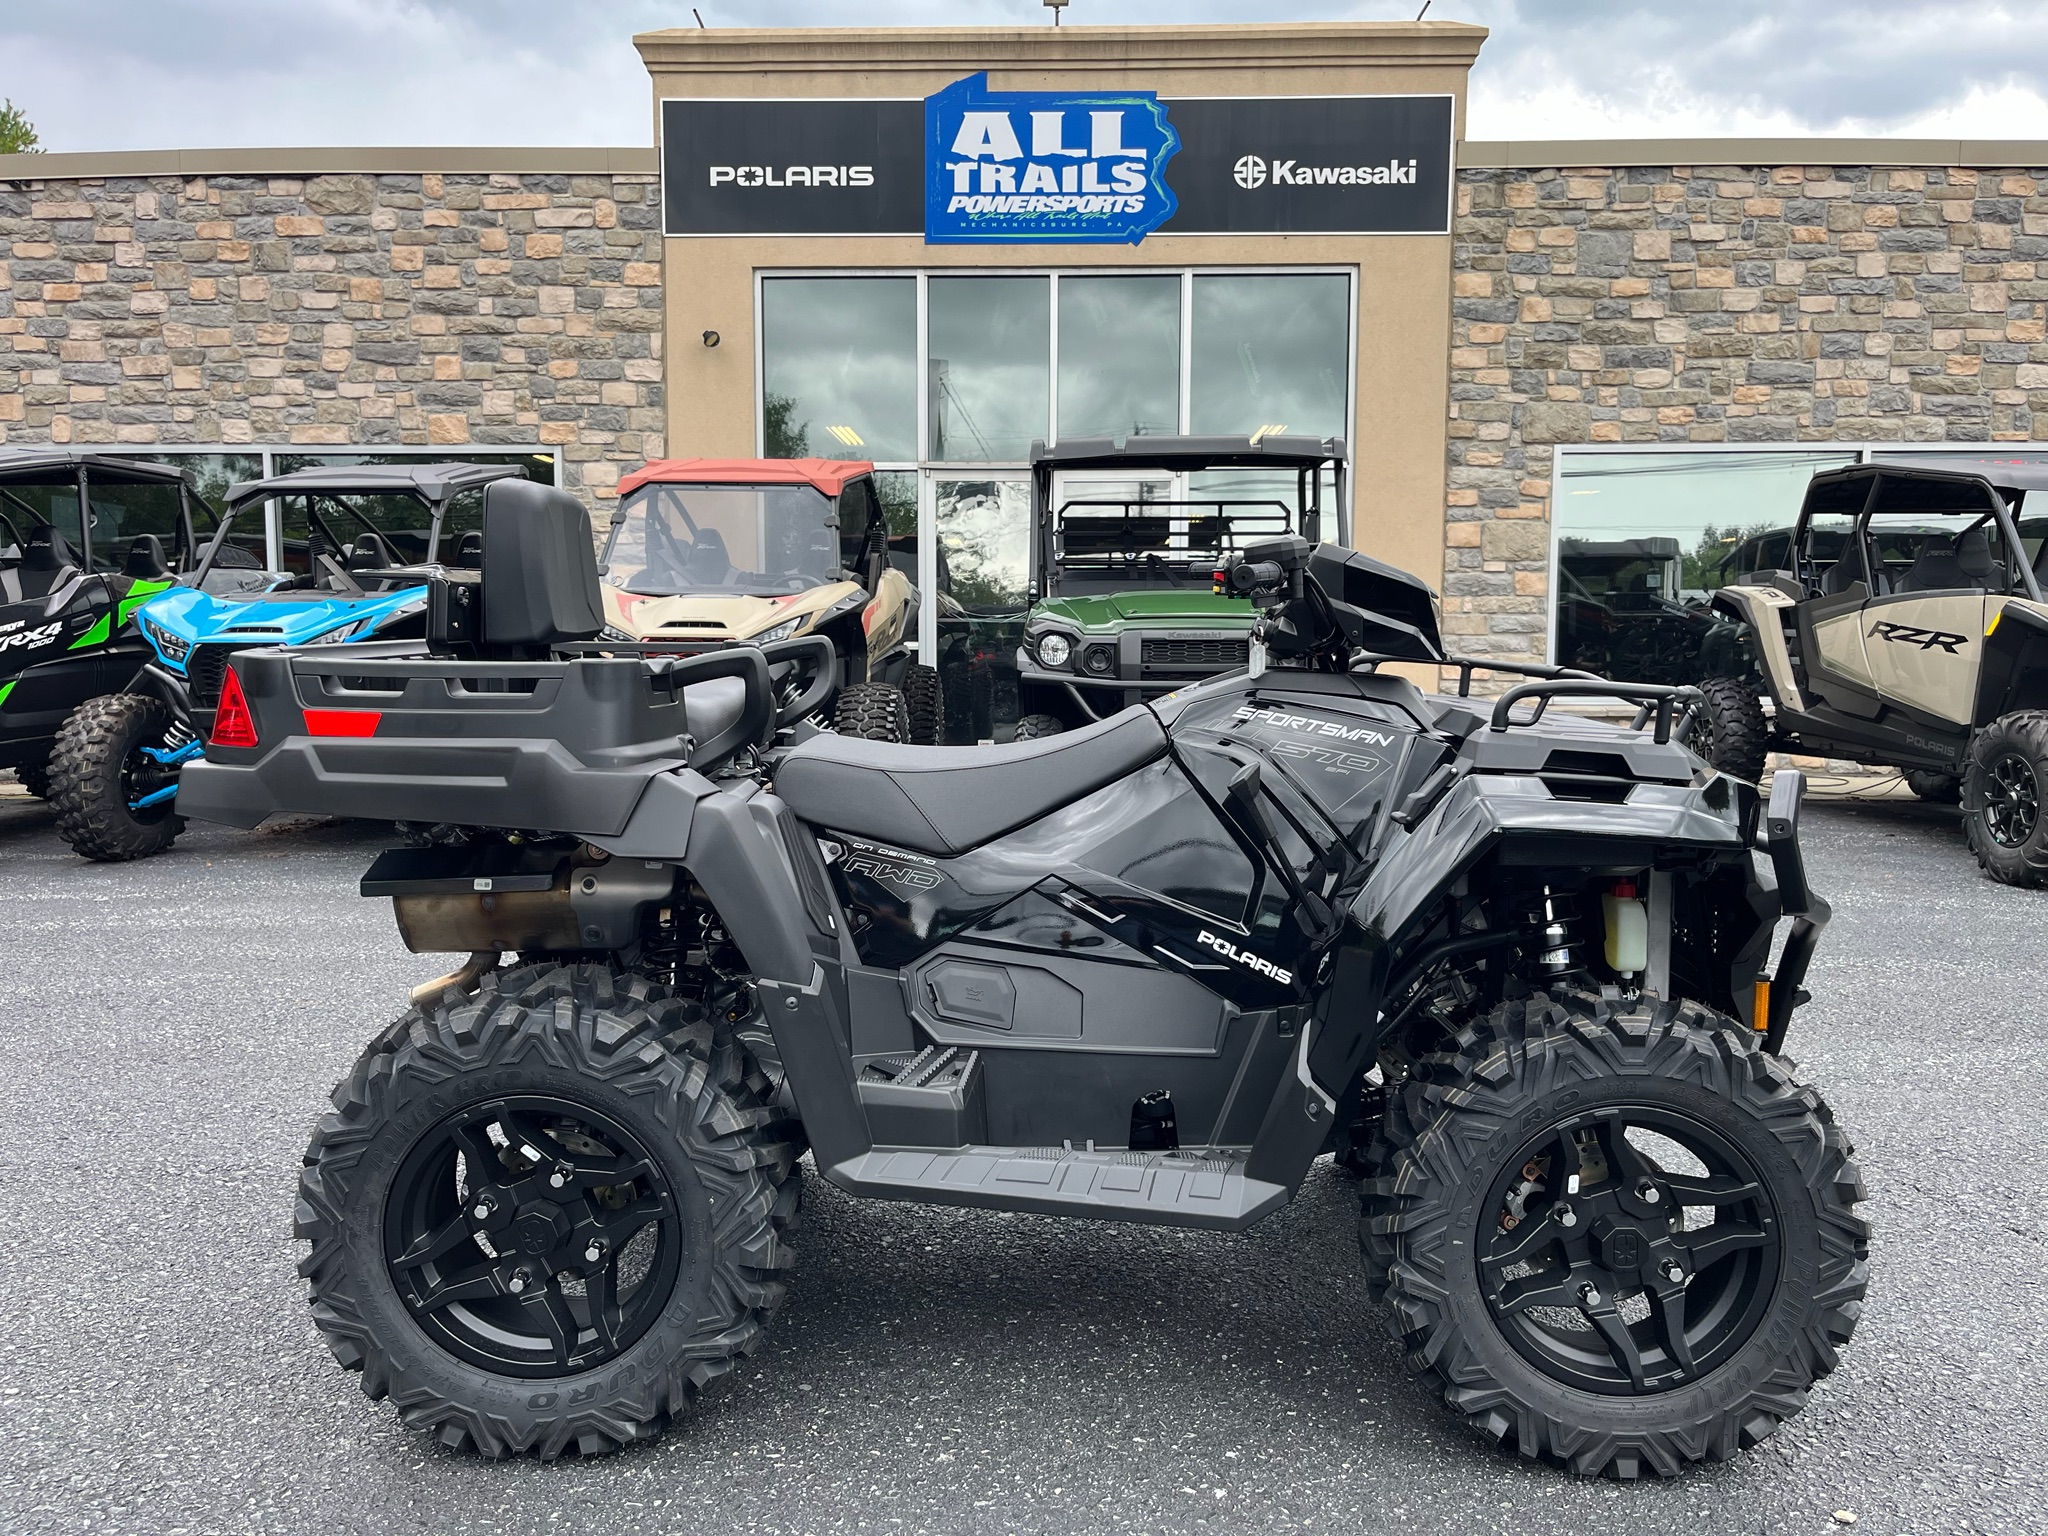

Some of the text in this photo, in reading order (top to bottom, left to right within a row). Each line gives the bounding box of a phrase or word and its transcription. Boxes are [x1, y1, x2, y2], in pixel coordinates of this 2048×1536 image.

[950, 111, 1147, 161] ALL
[709, 165, 875, 187] POLARIS
[945, 161, 1147, 193] TRAILS
[1272, 159, 1417, 185] Kawasaki
[946, 195, 1146, 214] POWERSPORTS
[27, 635, 56, 650] 1000
[1167, 631, 1222, 639] Kawasaki
[1866, 620, 1969, 655] RZR
[1231, 706, 1396, 748] SPORTSMAN
[1269, 739, 1381, 773] 570
[1906, 734, 1955, 757] POLARIS
[852, 842, 937, 866] ON DEMAND
[843, 857, 941, 889] AWD
[1196, 929, 1293, 985] POLARIS
[367, 1069, 523, 1175] POWER GRIP
[1466, 1088, 1582, 1197] DURO
[1684, 1255, 1815, 1421] POWER GRIP
[525, 1333, 667, 1412] DURO
